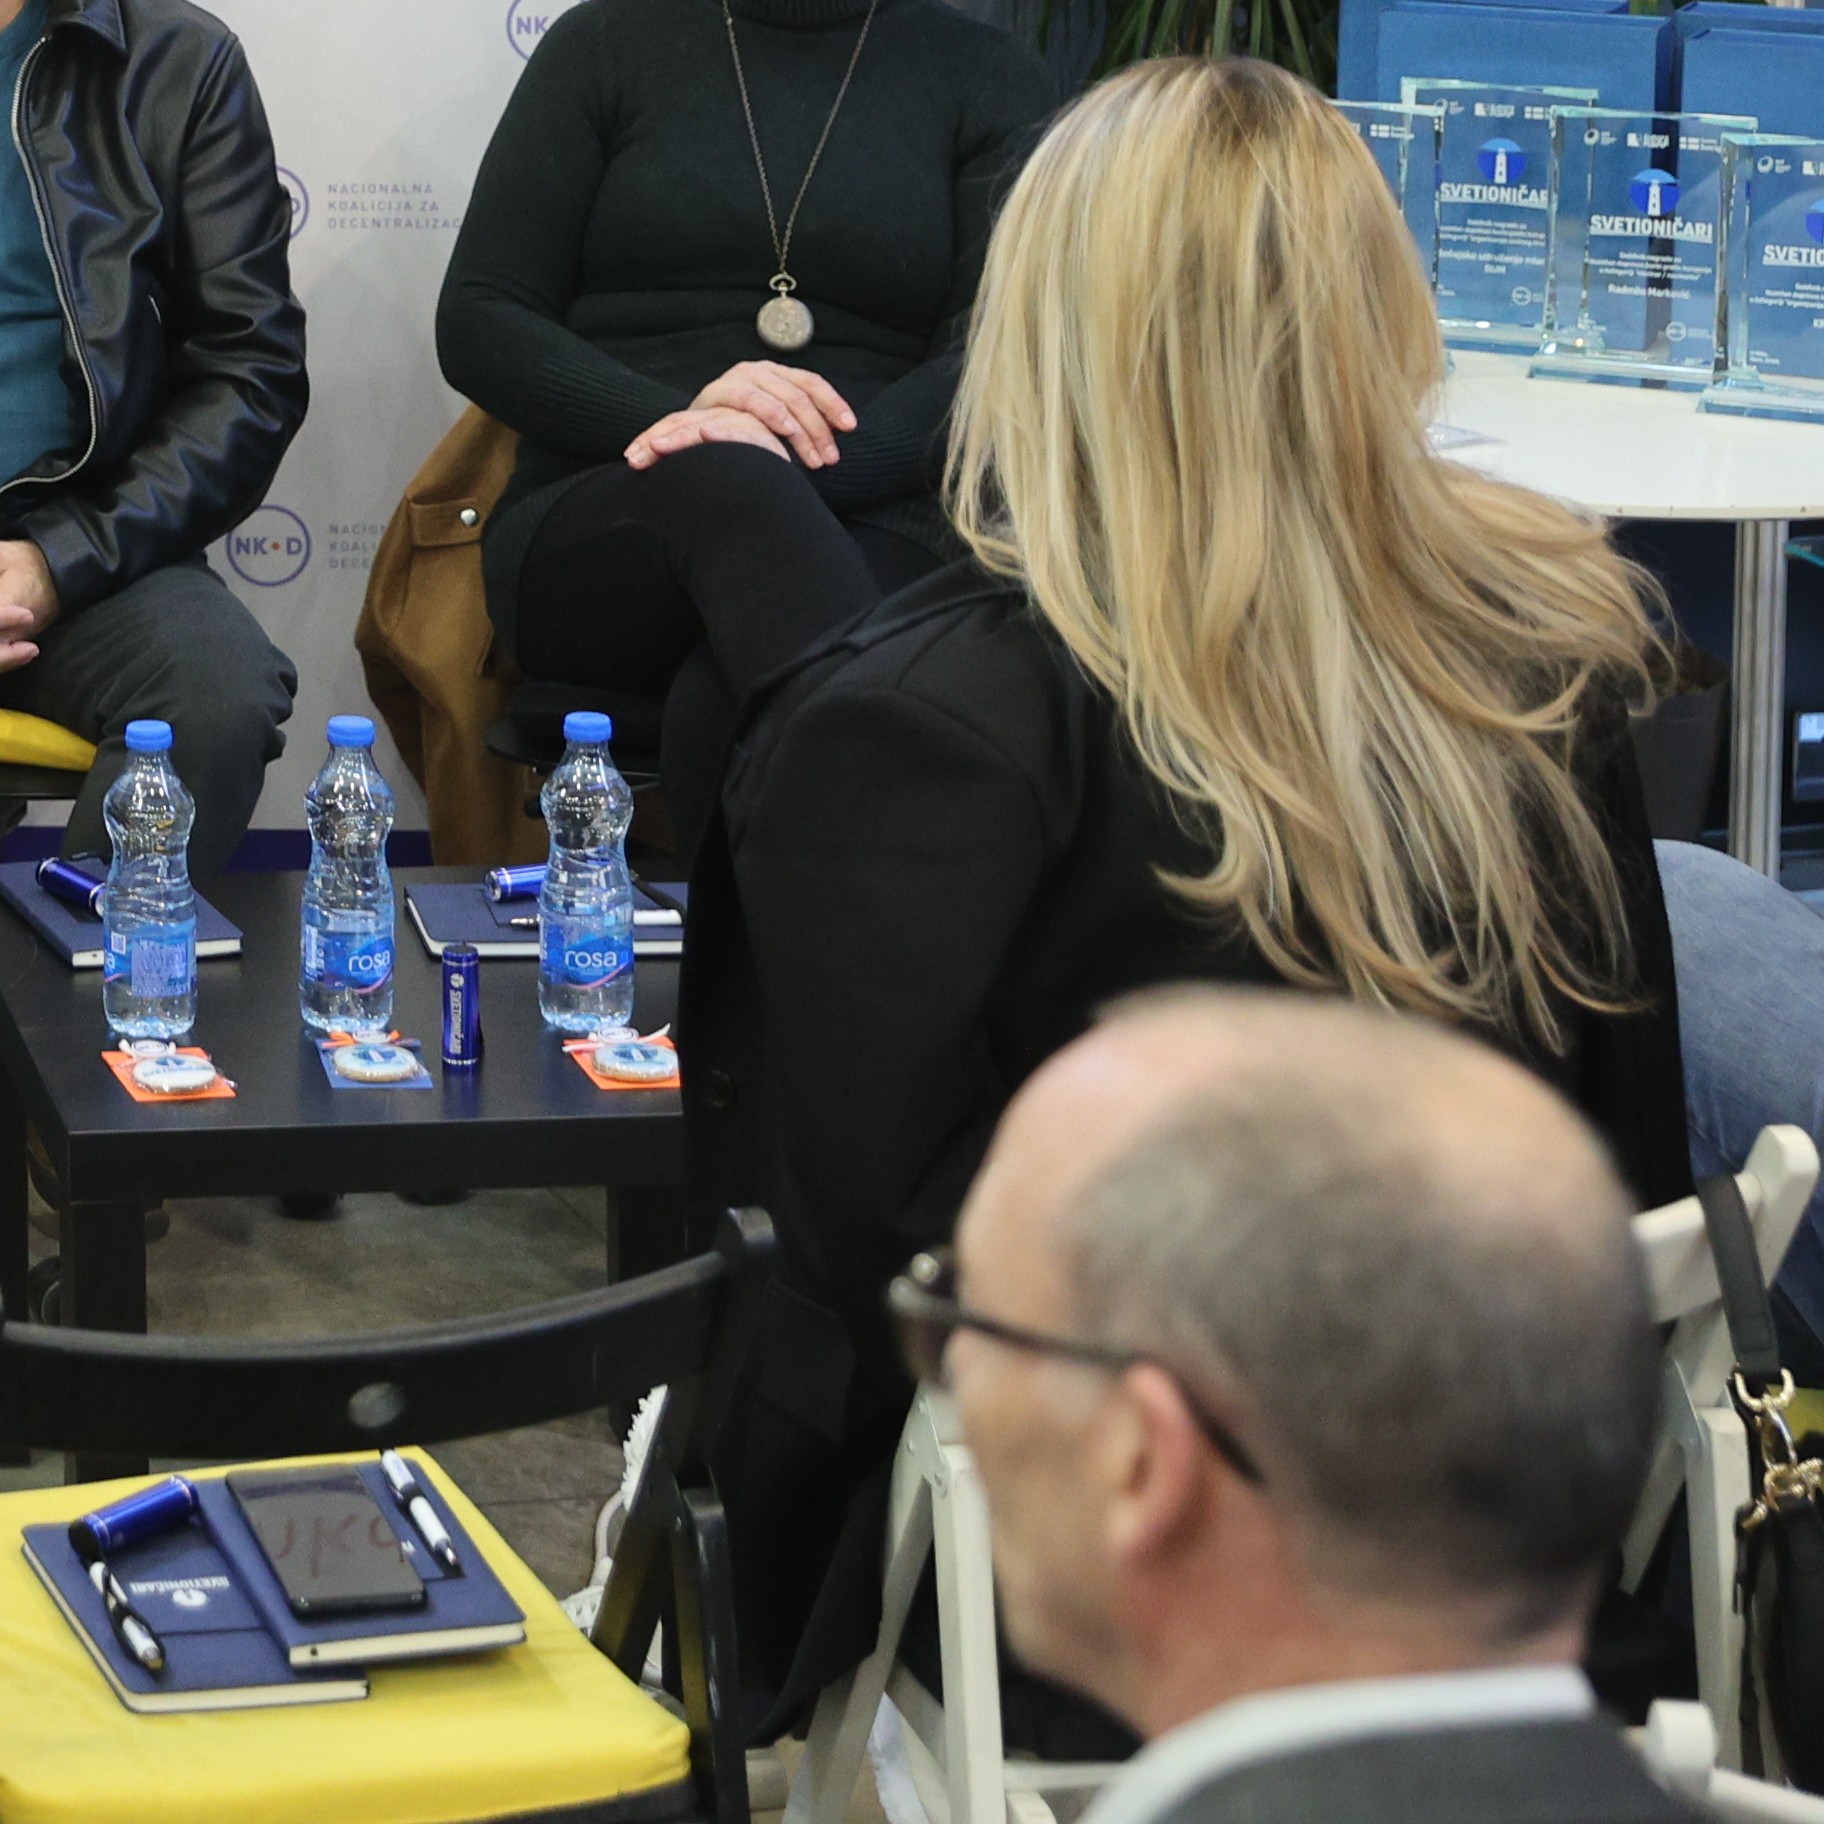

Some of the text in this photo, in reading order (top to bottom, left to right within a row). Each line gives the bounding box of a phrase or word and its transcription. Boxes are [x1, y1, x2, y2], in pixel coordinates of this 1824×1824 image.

[327, 183, 434, 195] NACIONALNA
[327, 200, 439, 212] KOALICIJA ZA
[1589, 214, 1713, 238] SVETIONIČARI
[348, 949, 391, 972] rosa
[564, 949, 618, 968] rosa
